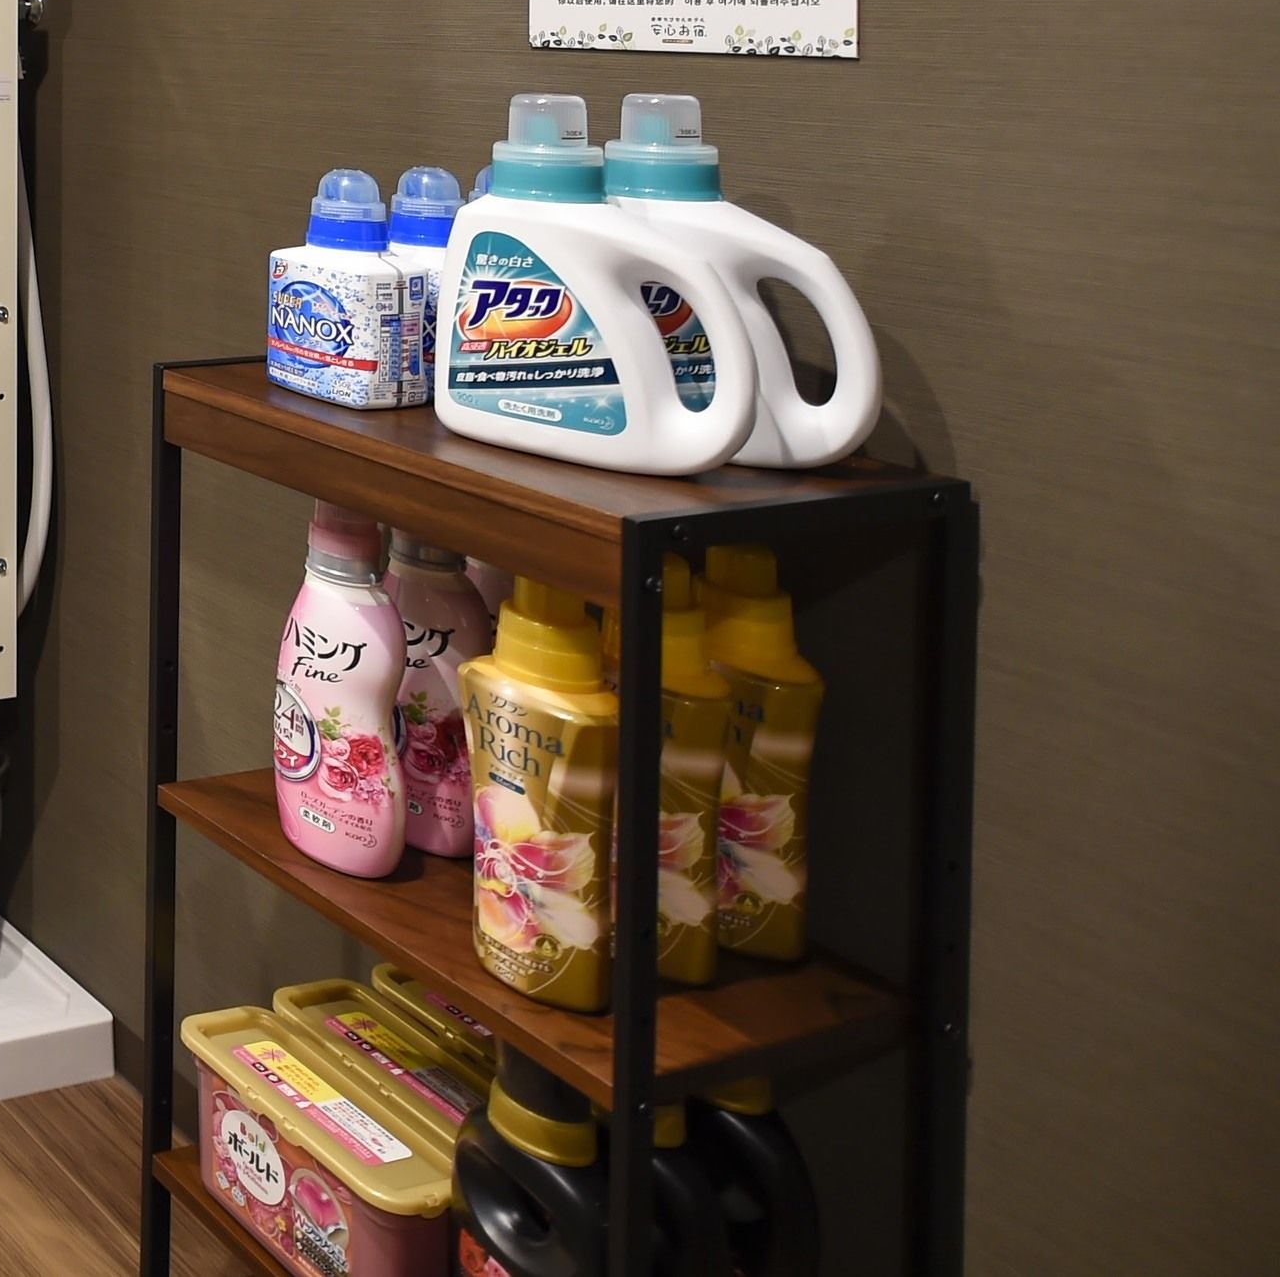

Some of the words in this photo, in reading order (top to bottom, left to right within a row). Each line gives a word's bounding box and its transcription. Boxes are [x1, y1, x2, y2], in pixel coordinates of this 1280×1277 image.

[475, 254, 534, 269] 驚きの白さ
[271, 304, 354, 345] NANOX
[467, 279, 566, 328] アタック
[484, 336, 593, 360] バイオジェル
[283, 616, 368, 672] ハミング
[402, 620, 456, 658] ング
[291, 655, 343, 684] Fine
[466, 692, 565, 758] Aroma
[480, 724, 541, 777] Rich
[227, 1130, 280, 1185] ボールド
